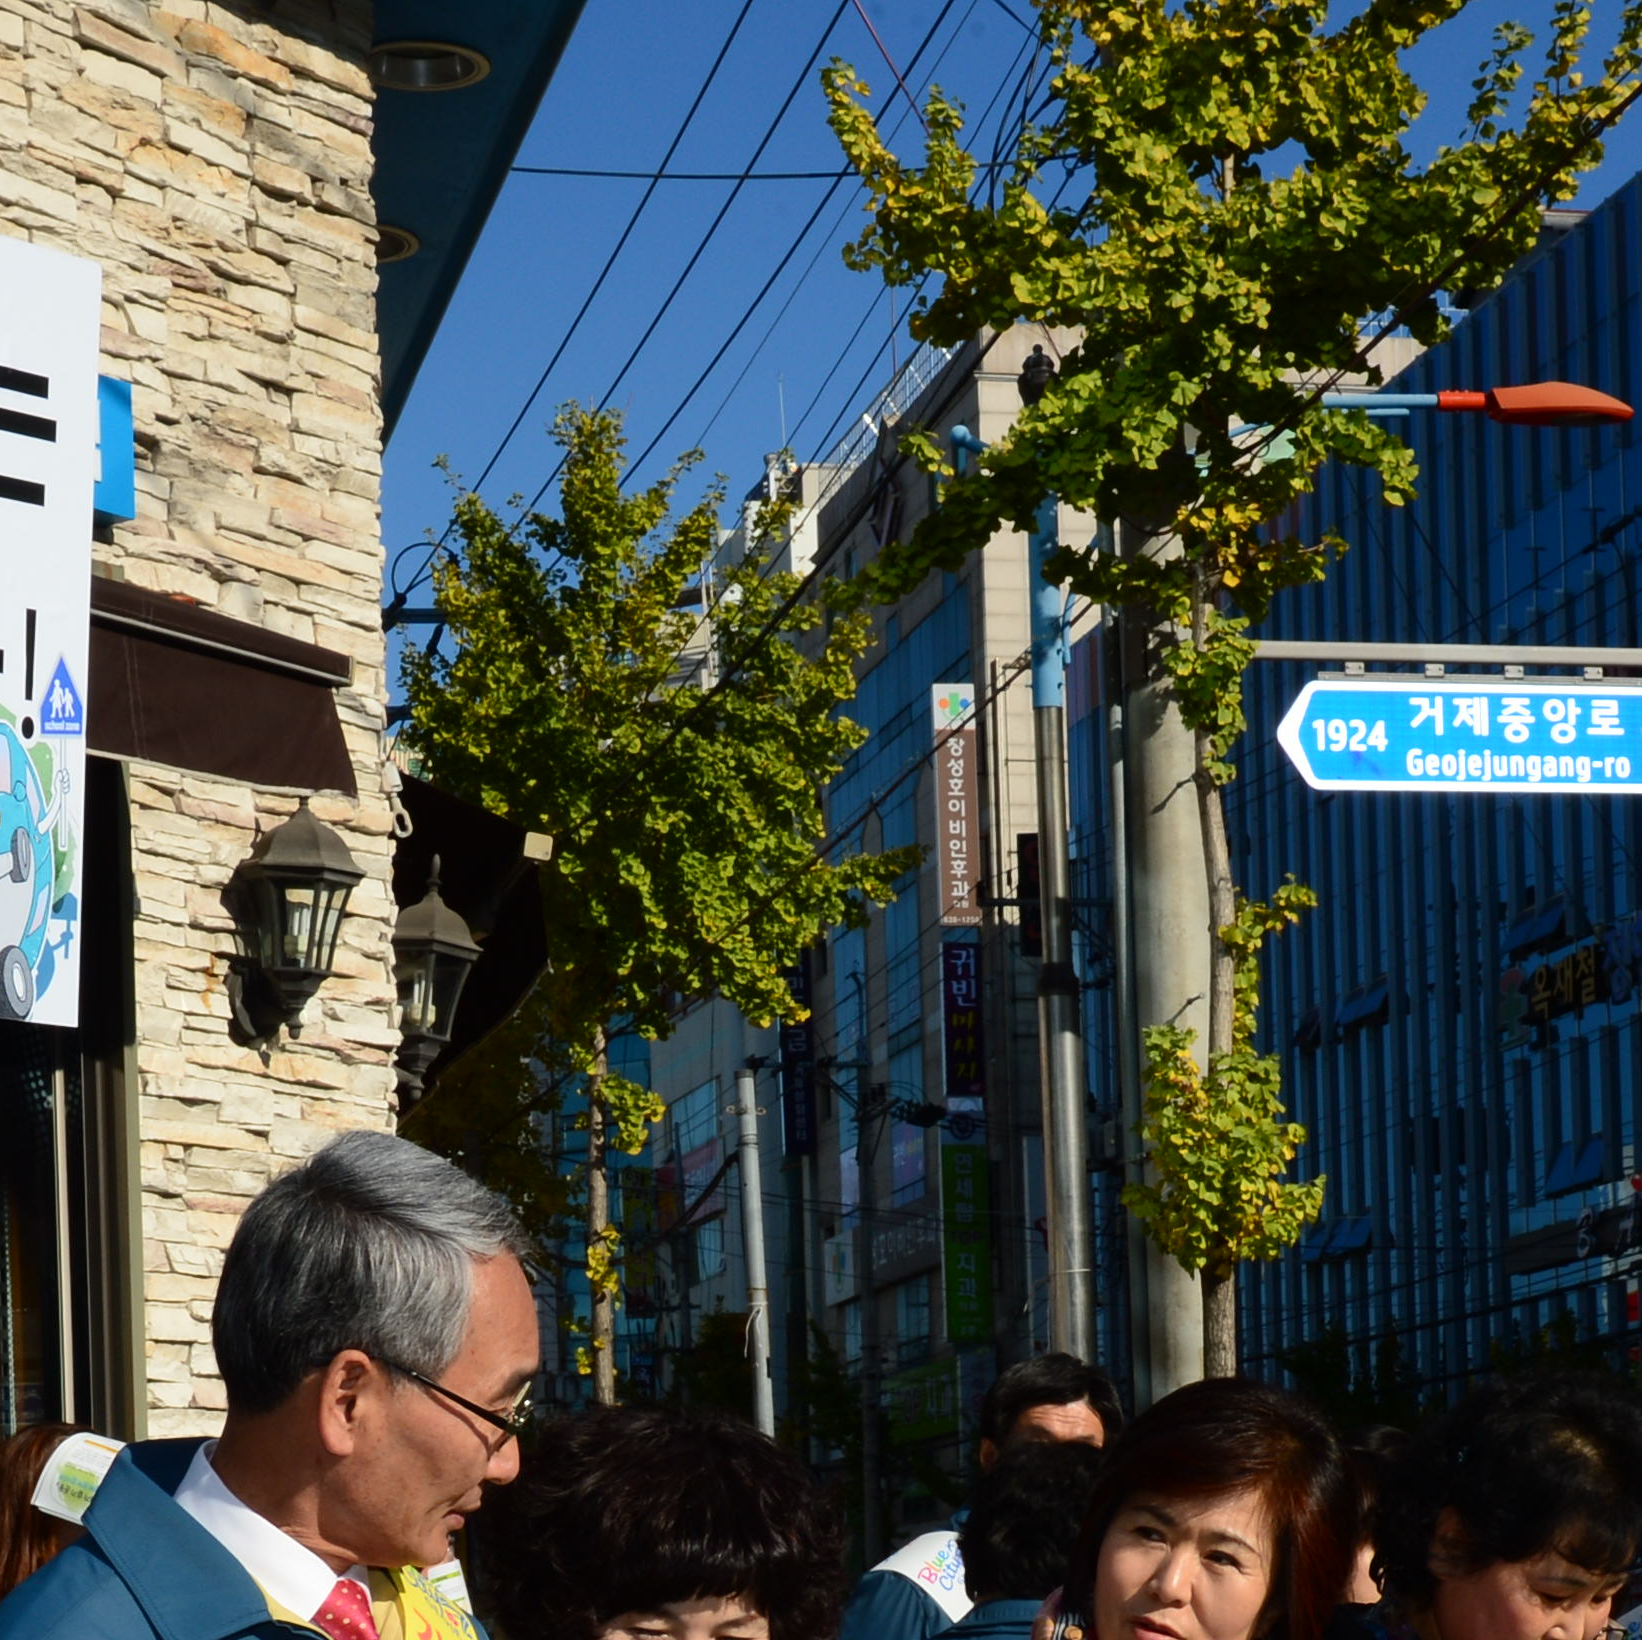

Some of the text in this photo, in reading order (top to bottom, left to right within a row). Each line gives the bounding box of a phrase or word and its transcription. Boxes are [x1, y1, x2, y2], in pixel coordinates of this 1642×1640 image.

[1408, 696, 1625, 743] 거제중앙로
[1311, 719, 1388, 752] 1924
[1406, 747, 1632, 783] Geojejungang-ro
